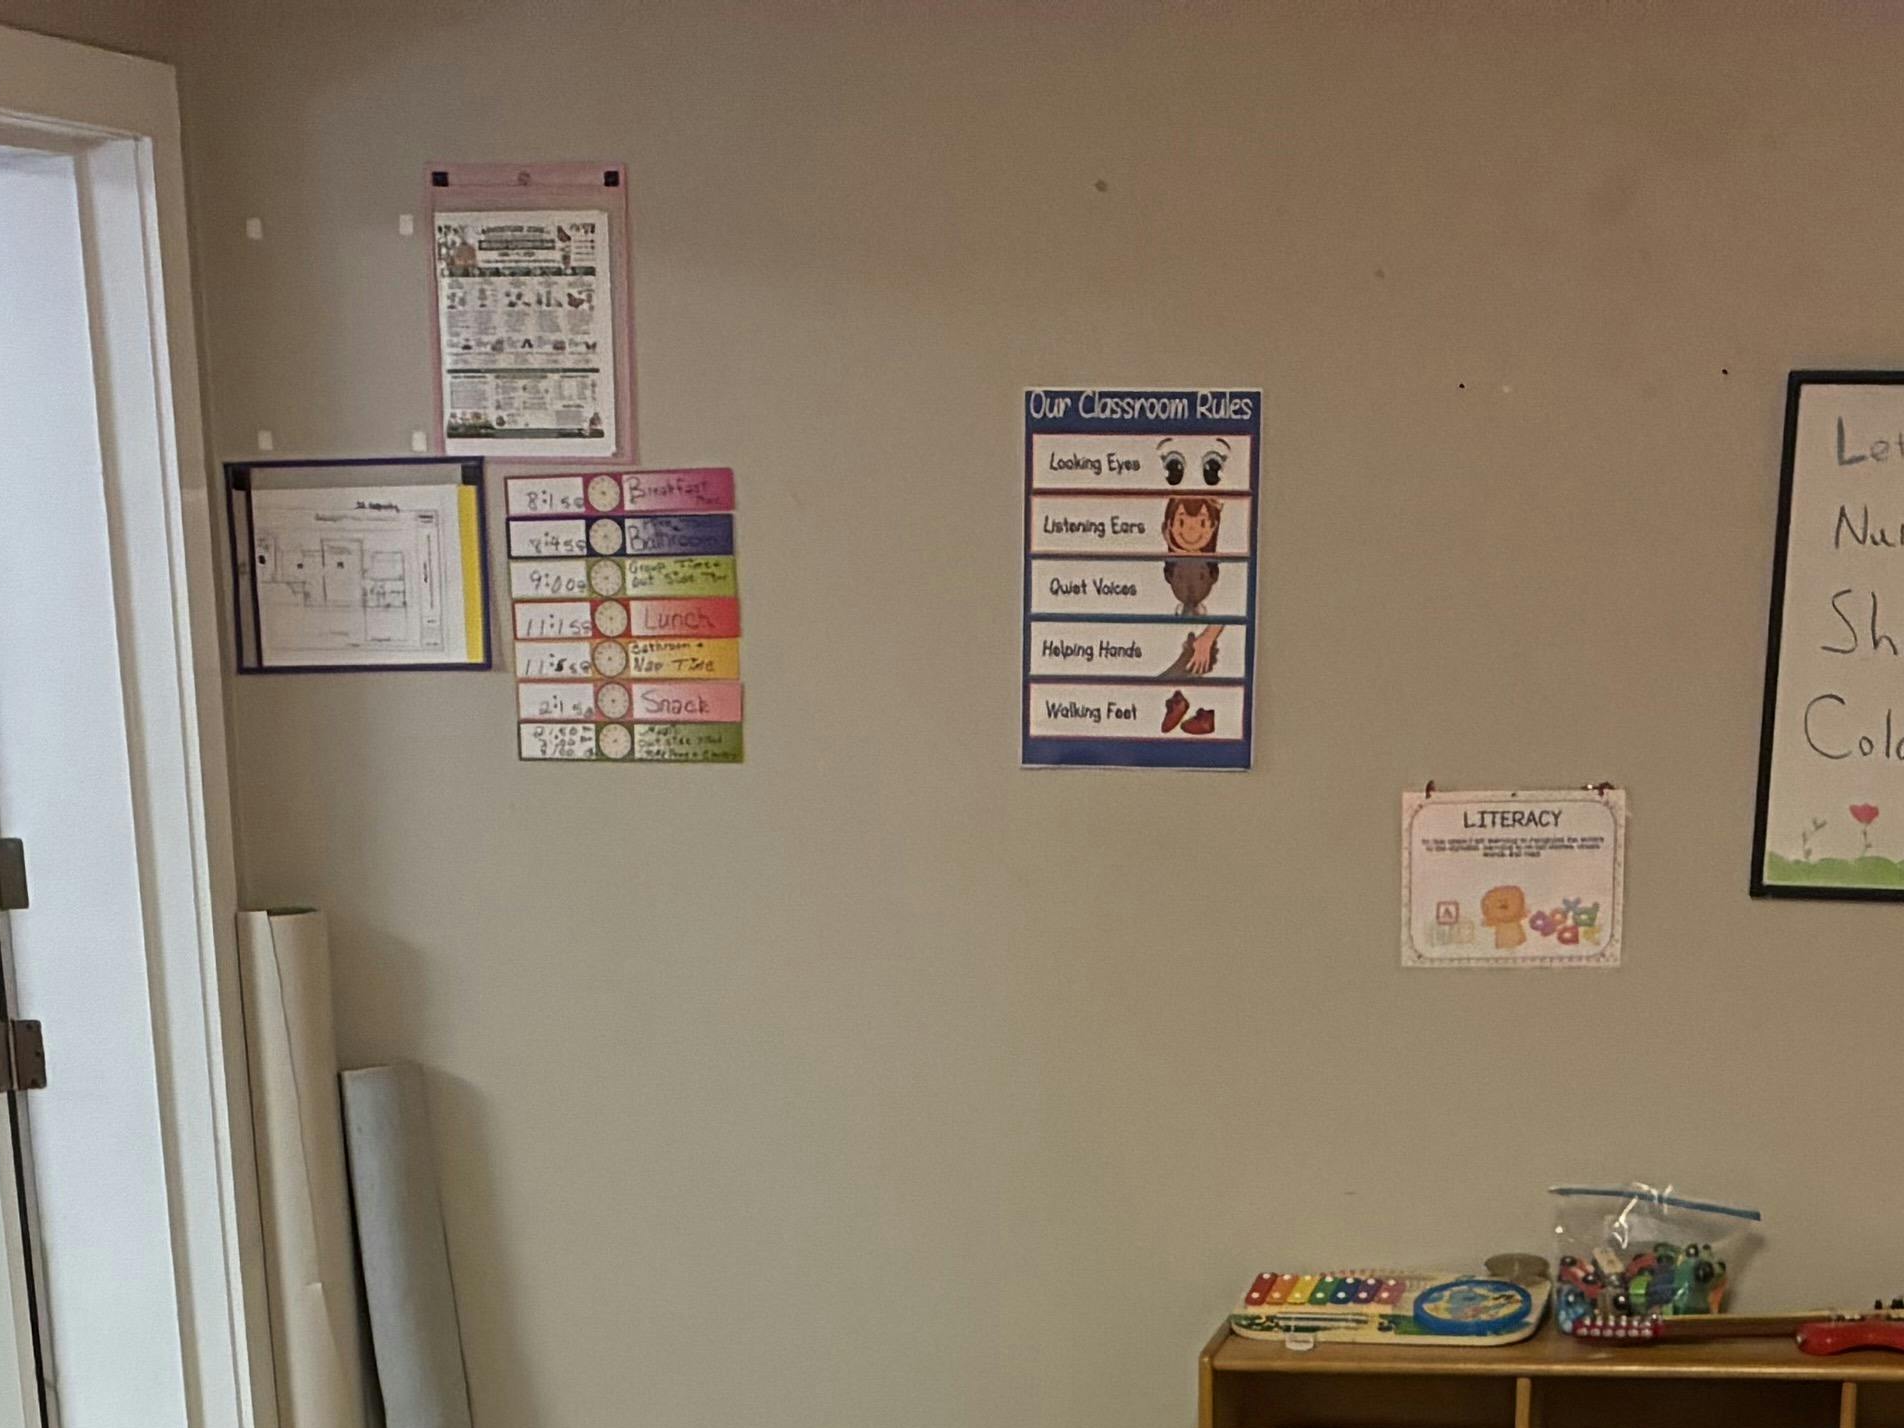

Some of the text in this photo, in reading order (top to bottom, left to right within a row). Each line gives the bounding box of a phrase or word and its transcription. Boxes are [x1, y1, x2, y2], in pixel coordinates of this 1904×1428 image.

[1030, 390, 1253, 421] Our Classroom Rules
[1049, 453, 1141, 476] Looking Eyes
[1043, 514, 1146, 538] Listening Ears
[1049, 577, 1138, 597] Quiet Voices
[644, 605, 716, 631] Lunch
[1041, 639, 1143, 662] Helping Hands
[641, 690, 711, 715] Snack
[1045, 700, 1138, 723] Walking Feet
[1463, 809, 1563, 830] LITERACY
